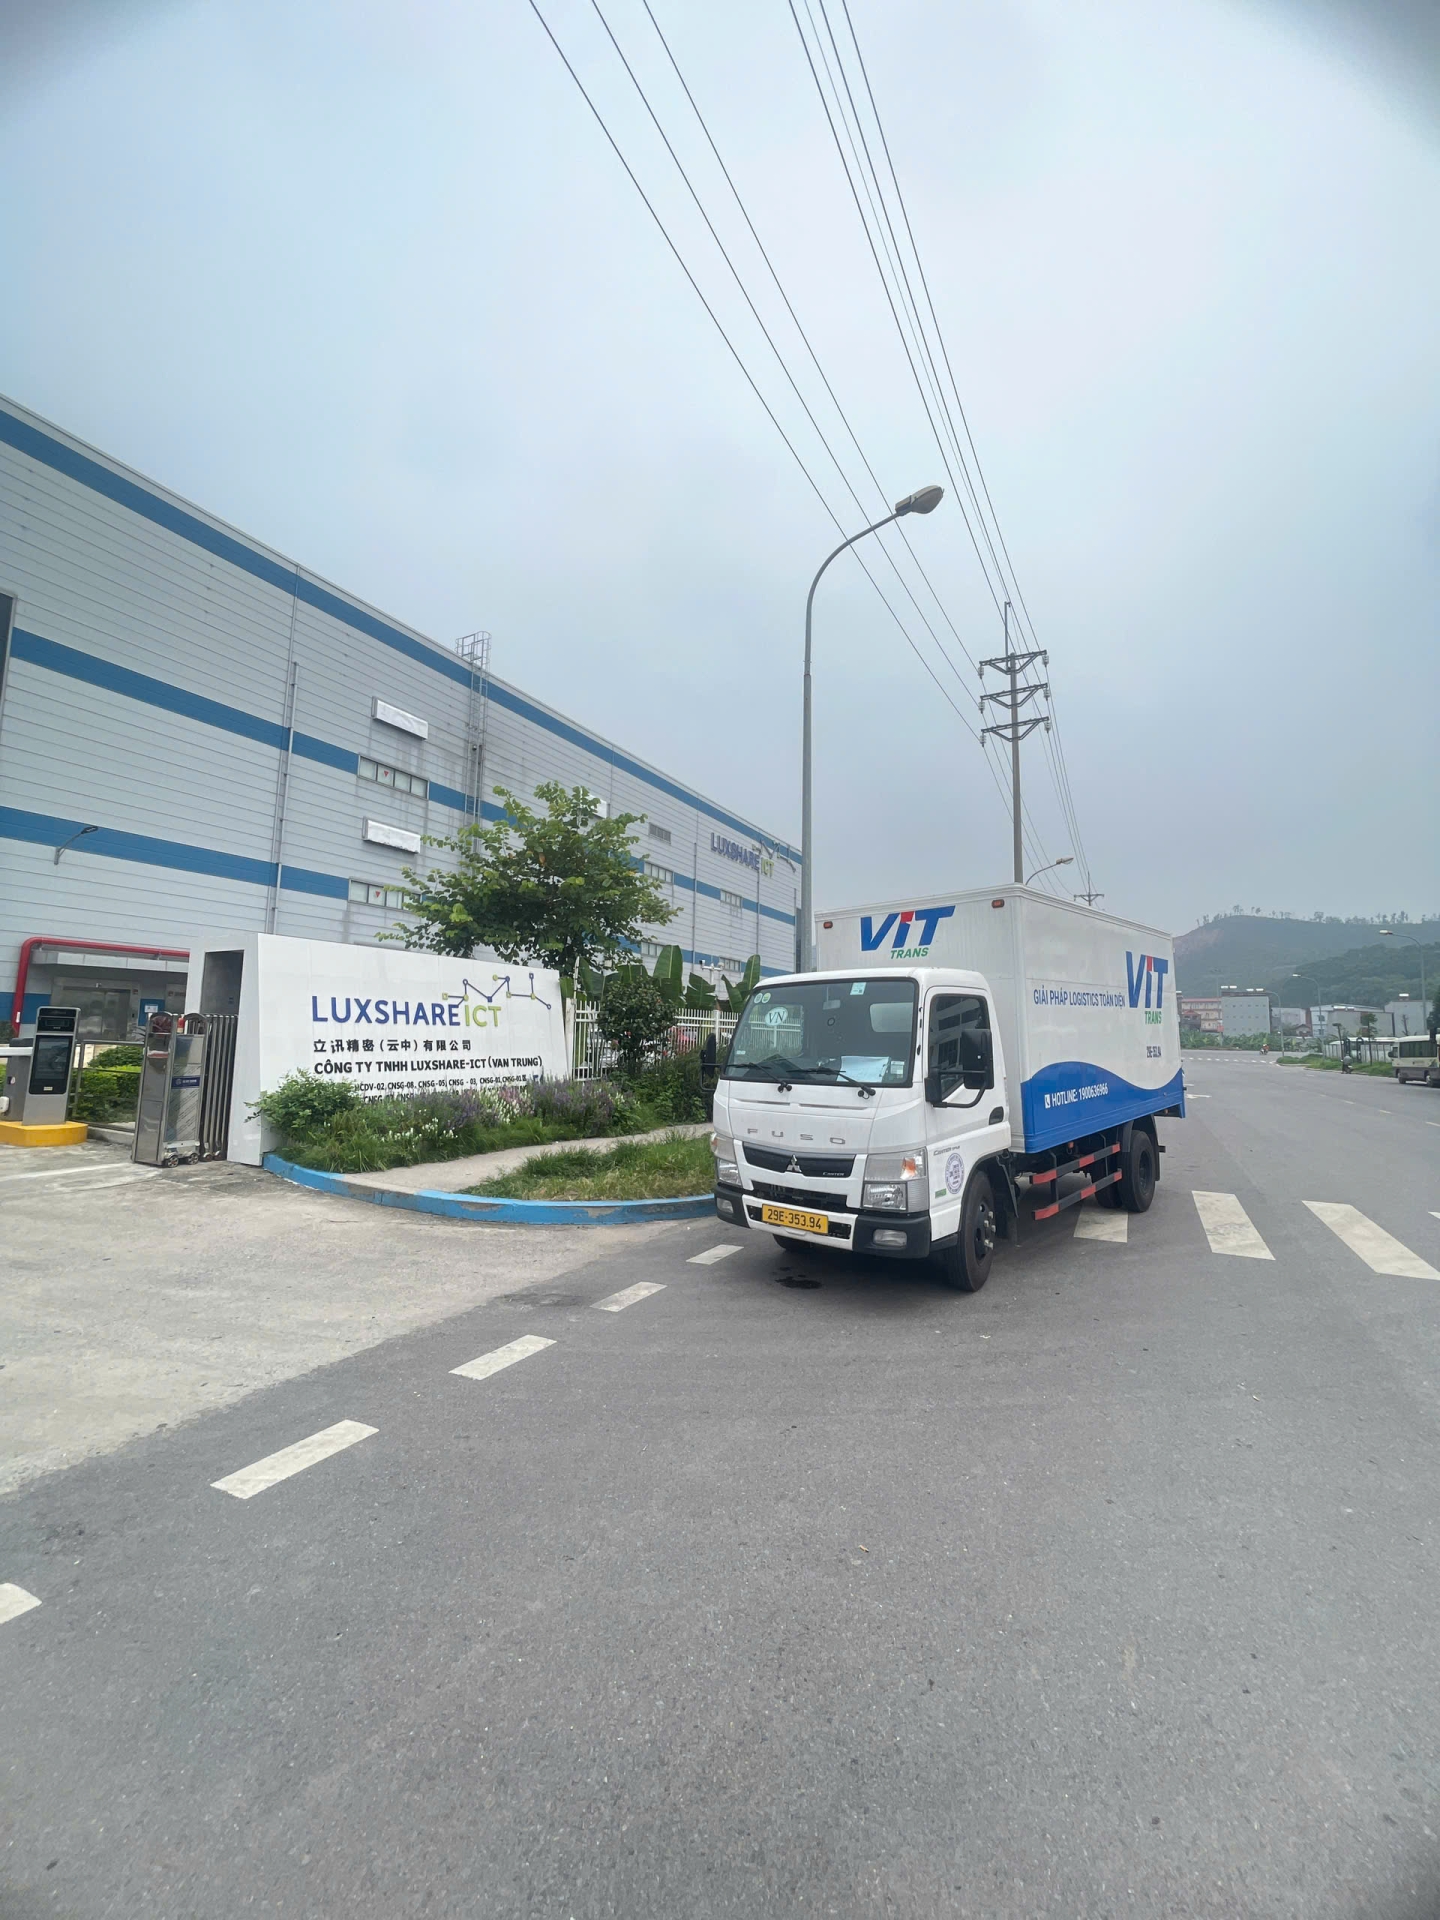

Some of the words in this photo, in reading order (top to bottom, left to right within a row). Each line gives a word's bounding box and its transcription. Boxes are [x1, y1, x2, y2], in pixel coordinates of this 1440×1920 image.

[711, 832, 760, 871] LUXSHARE
[890, 947, 929, 959] TRANS
[1034, 985, 1048, 1005] GIẢI
[1050, 987, 1068, 1005] PHÁP
[1069, 992, 1099, 1007] LOGISTICS
[1099, 991, 1113, 1007] TOÀN
[769, 1010, 786, 1024] VN
[1145, 1011, 1162, 1024] TRANS
[314, 1059, 352, 1074] CÔNG
[355, 1061, 373, 1072] TY
[376, 1061, 408, 1072] TNHH
[411, 1058, 486, 1071] LUXSHARE-ICT
[511, 1055, 542, 1067] TRUNG)
[1052, 1088, 1078, 1107] HOTLINE:
[747, 1128, 846, 1145] FUSO
[767, 1208, 822, 1229] 29E-353.94
